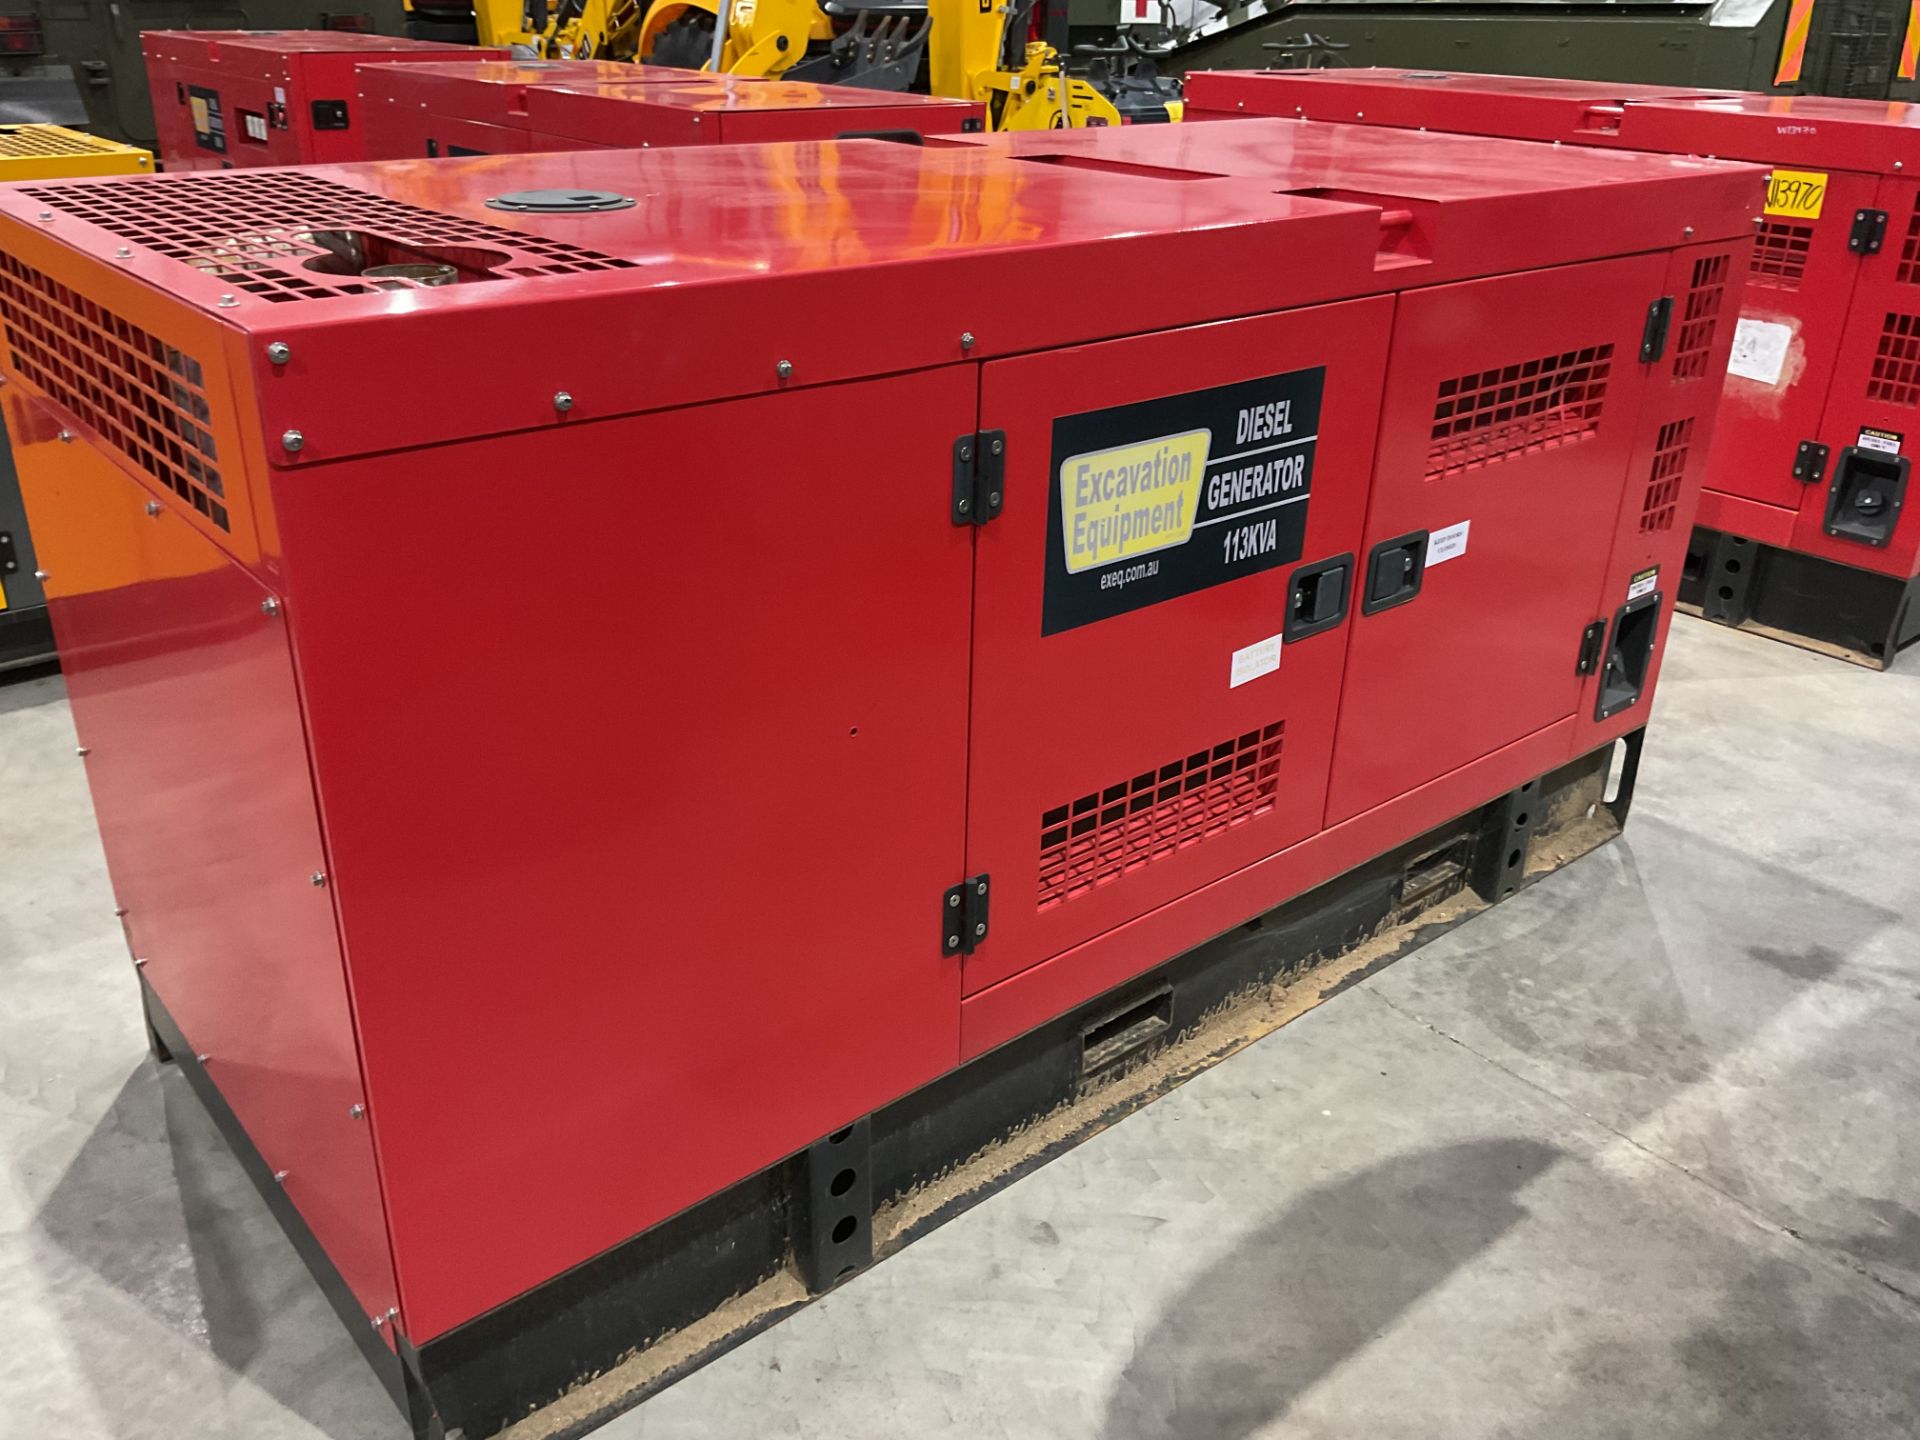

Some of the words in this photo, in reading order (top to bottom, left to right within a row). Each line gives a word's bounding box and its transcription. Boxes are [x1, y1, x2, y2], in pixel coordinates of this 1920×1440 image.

[1236, 400, 1292, 444] DIESEL
[1075, 447, 1192, 507] Excavation
[1207, 454, 1305, 511] GENERATOR
[1072, 490, 1184, 560] Equipment
[1223, 519, 1277, 564] 113KVA
[1100, 560, 1159, 589] exeq.com.au
